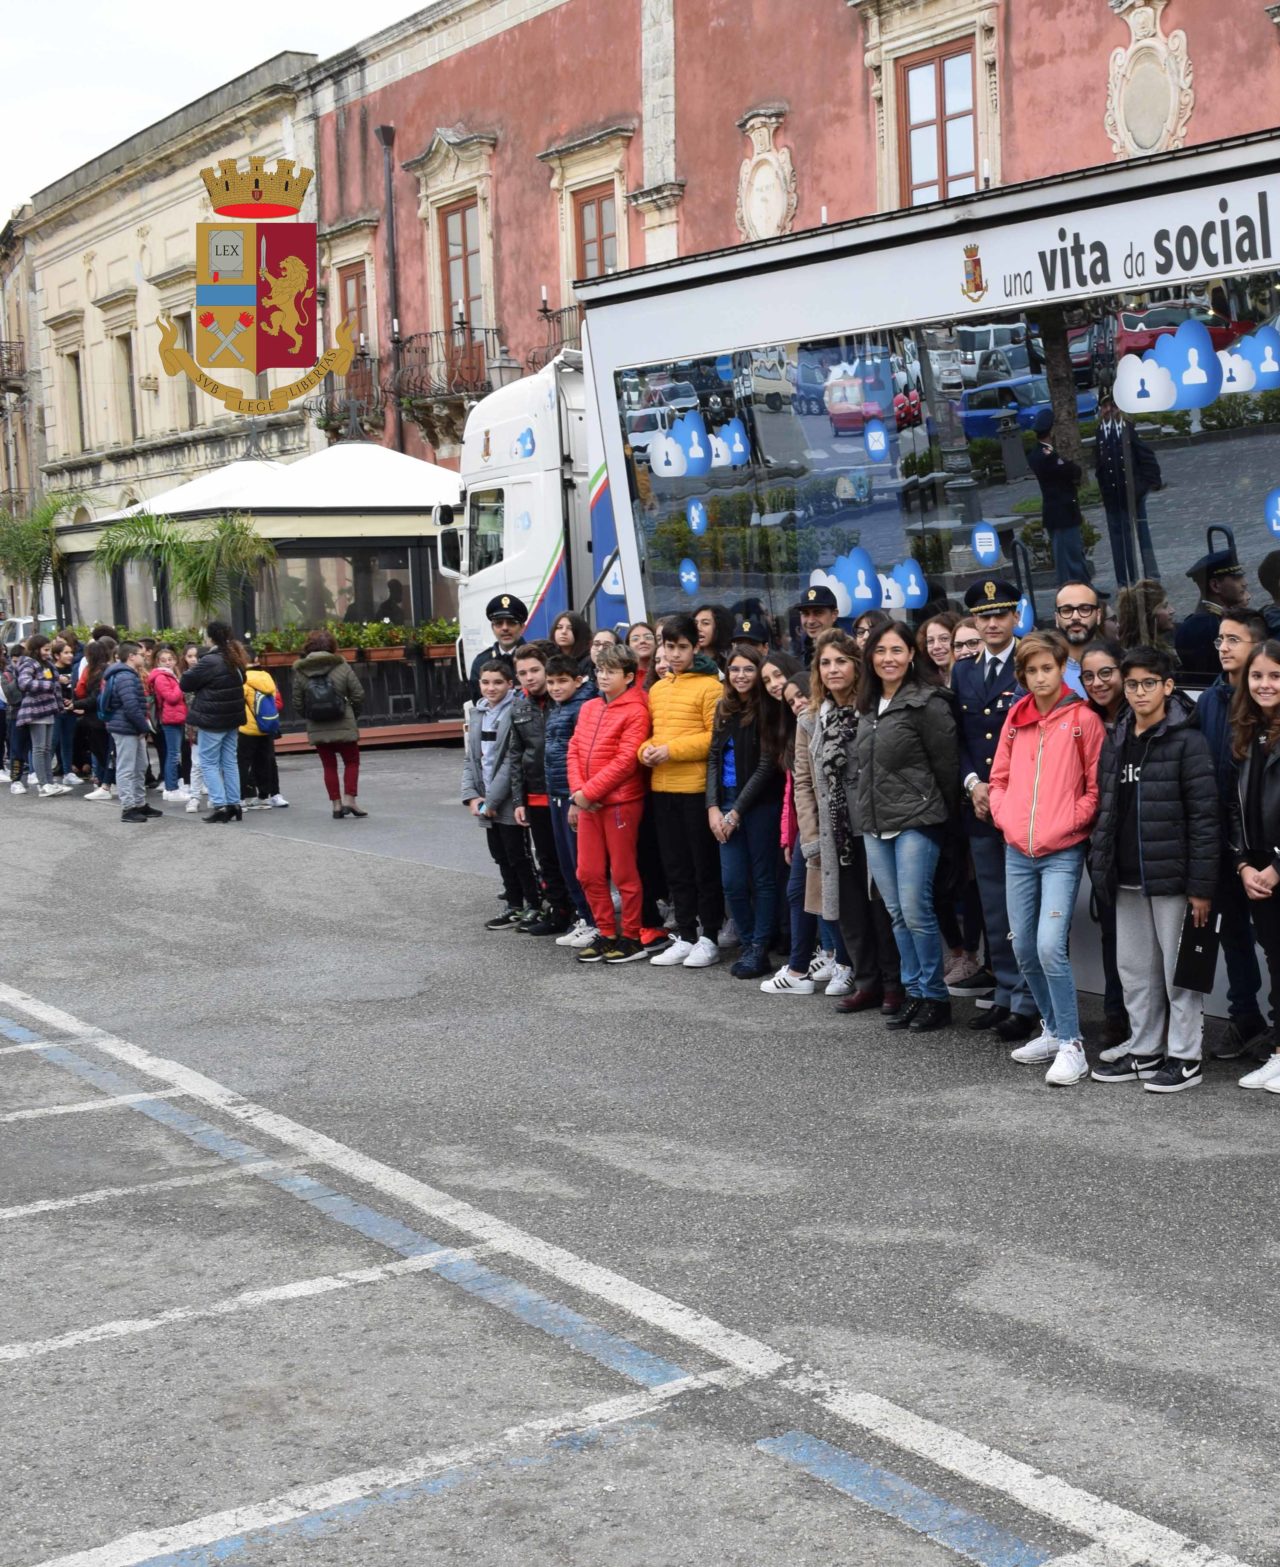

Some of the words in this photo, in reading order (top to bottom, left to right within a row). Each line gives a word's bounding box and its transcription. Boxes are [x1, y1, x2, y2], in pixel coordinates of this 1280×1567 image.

[1003, 270, 1033, 297] una
[1037, 227, 1111, 292] vita
[1123, 241, 1145, 280] da
[1154, 190, 1272, 275] social
